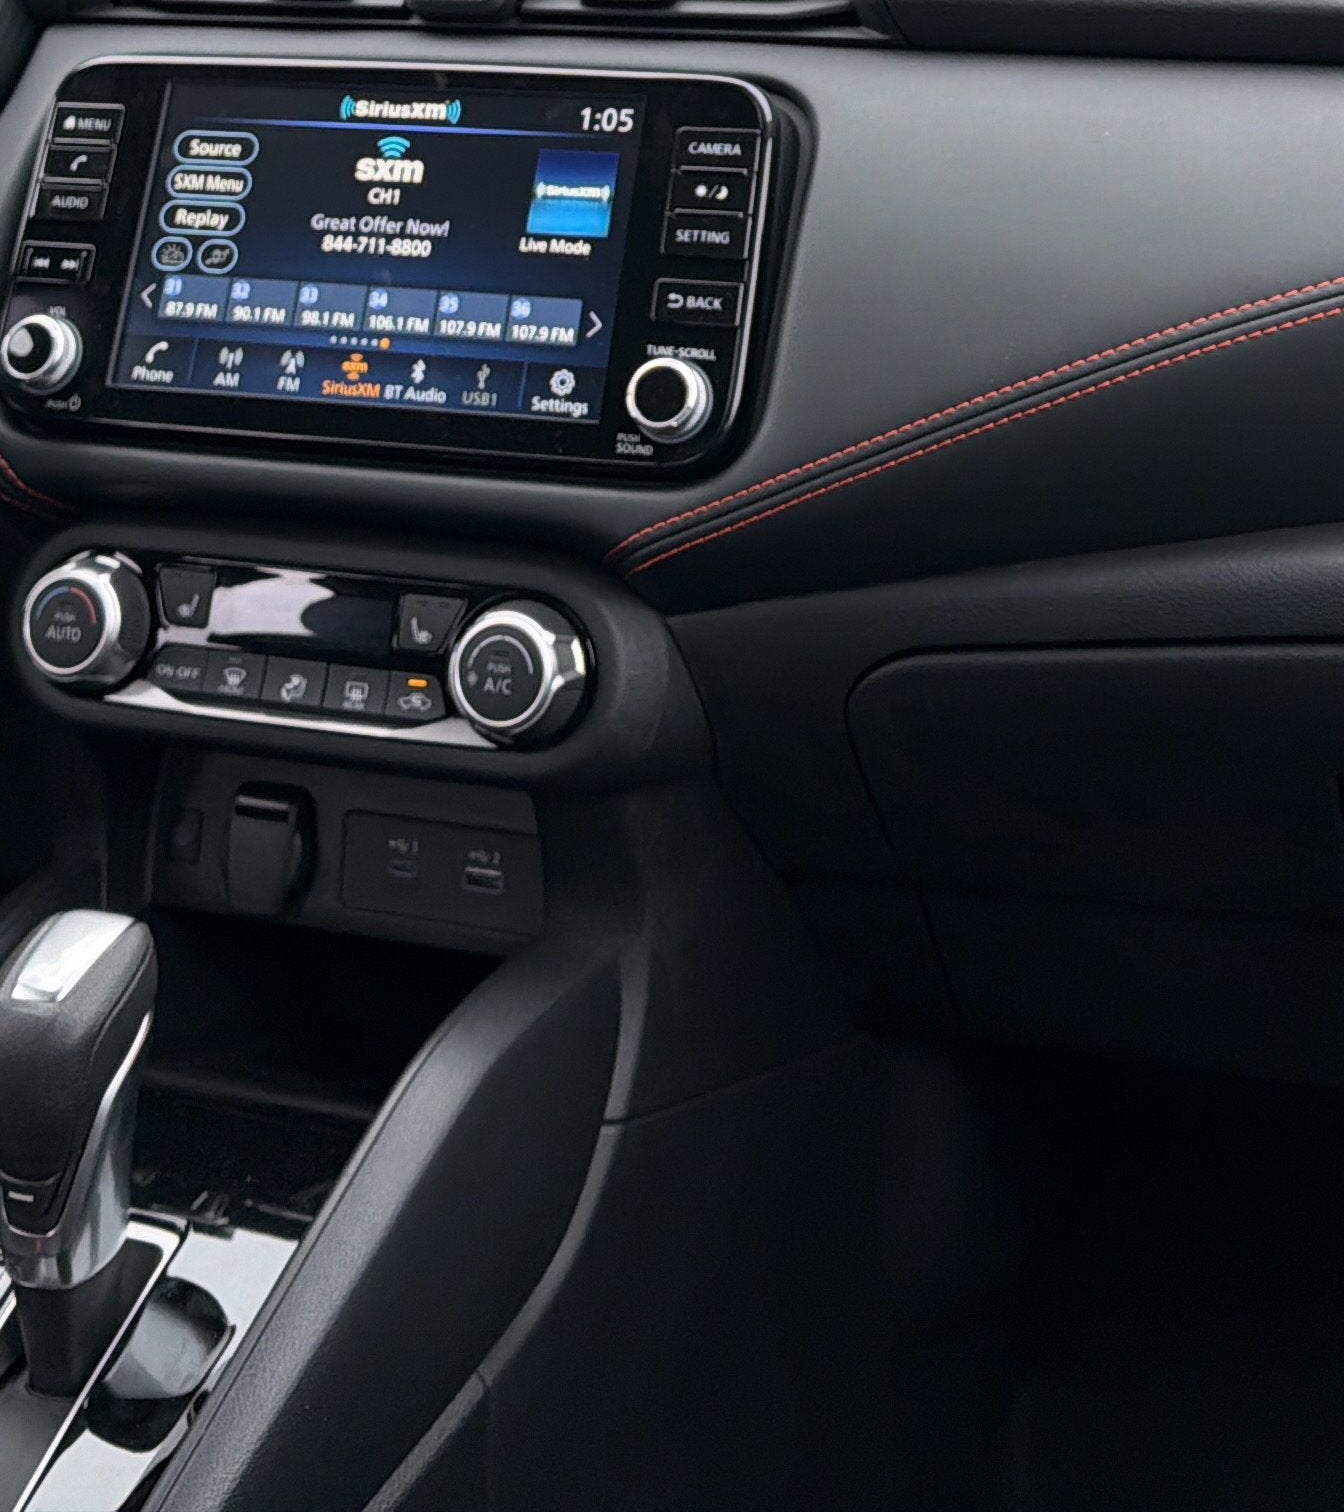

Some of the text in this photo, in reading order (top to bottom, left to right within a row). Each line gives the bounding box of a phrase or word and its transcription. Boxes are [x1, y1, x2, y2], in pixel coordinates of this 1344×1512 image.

[77, 118, 112, 131] MENU
[579, 106, 635, 133] 1:05
[189, 138, 242, 158] Source
[688, 141, 742, 157] CAMERA
[173, 173, 244, 193] SXM Menu
[51, 195, 88, 210] AUDIO
[367, 187, 401, 206] CH1
[174, 208, 230, 231] Replay
[310, 213, 451, 238] Great Offer Now!
[675, 228, 730, 244] SETTING
[321, 234, 432, 258] 844-711-8800
[519, 237, 591, 256] Live Mode
[164, 301, 218, 320] 87.9 FM
[686, 296, 722, 311] BACK
[262, 307, 286, 323] FM
[331, 311, 355, 327] FM
[368, 315, 429, 334] 106.1 FM
[439, 319, 501, 338] 107.9 FM
[512, 325, 574, 343] 107.9 FM
[131, 365, 174, 384] Phone
[213, 372, 240, 388] AM
[277, 376, 300, 392] FM
[321, 380, 380, 398] SiriusXM
[383, 384, 447, 404] BT Audio
[461, 391, 497, 407] USB1
[531, 396, 588, 418] Settings
[615, 443, 653, 456] SOUND
[45, 625, 82, 643] AUTO
[486, 661, 511, 673] PUSH
[483, 676, 513, 695] A/C
